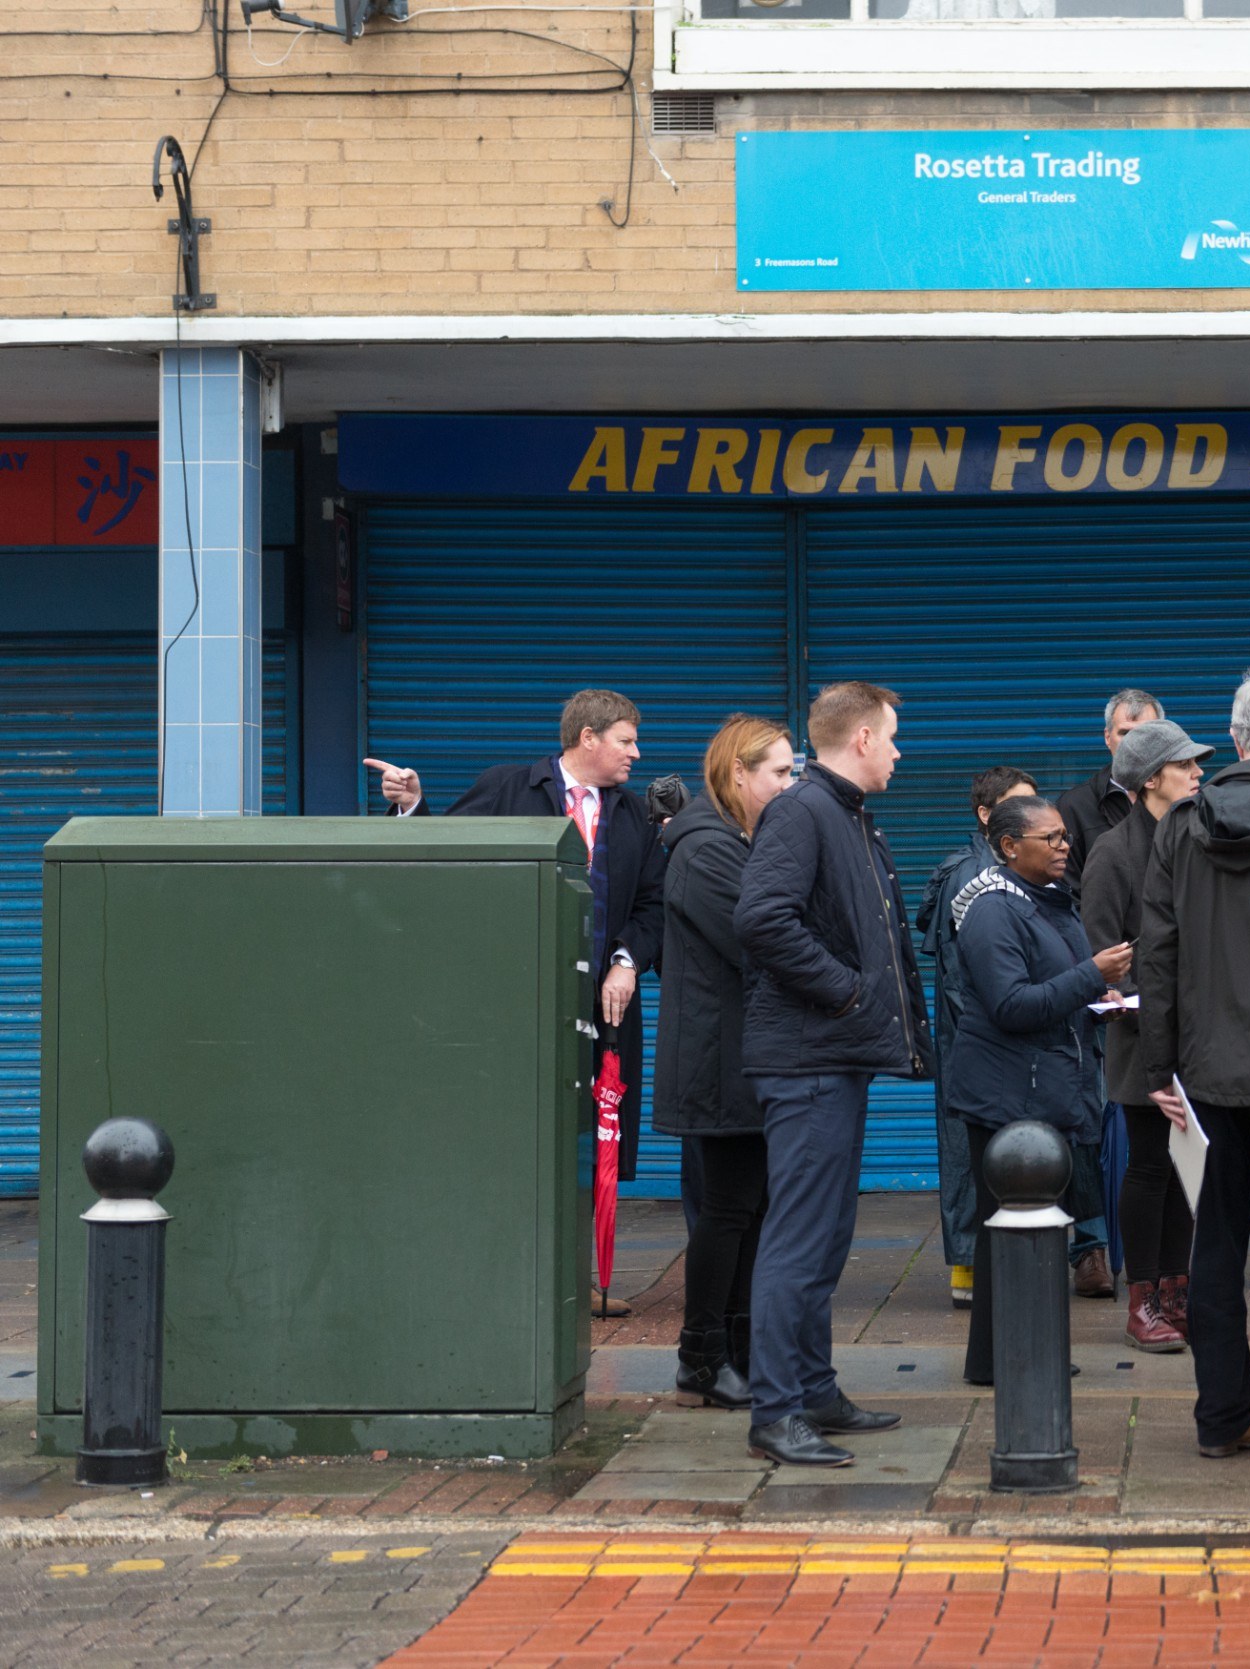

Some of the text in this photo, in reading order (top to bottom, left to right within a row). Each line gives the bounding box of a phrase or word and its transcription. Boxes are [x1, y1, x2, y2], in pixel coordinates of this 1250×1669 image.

[914, 151, 1141, 185] Rosetta Trading
[977, 190, 1077, 203] General Traders
[755, 257, 838, 267] 3 Freemasons Road
[568, 426, 966, 495] AFRICAN
[990, 423, 1229, 492] FOOD
